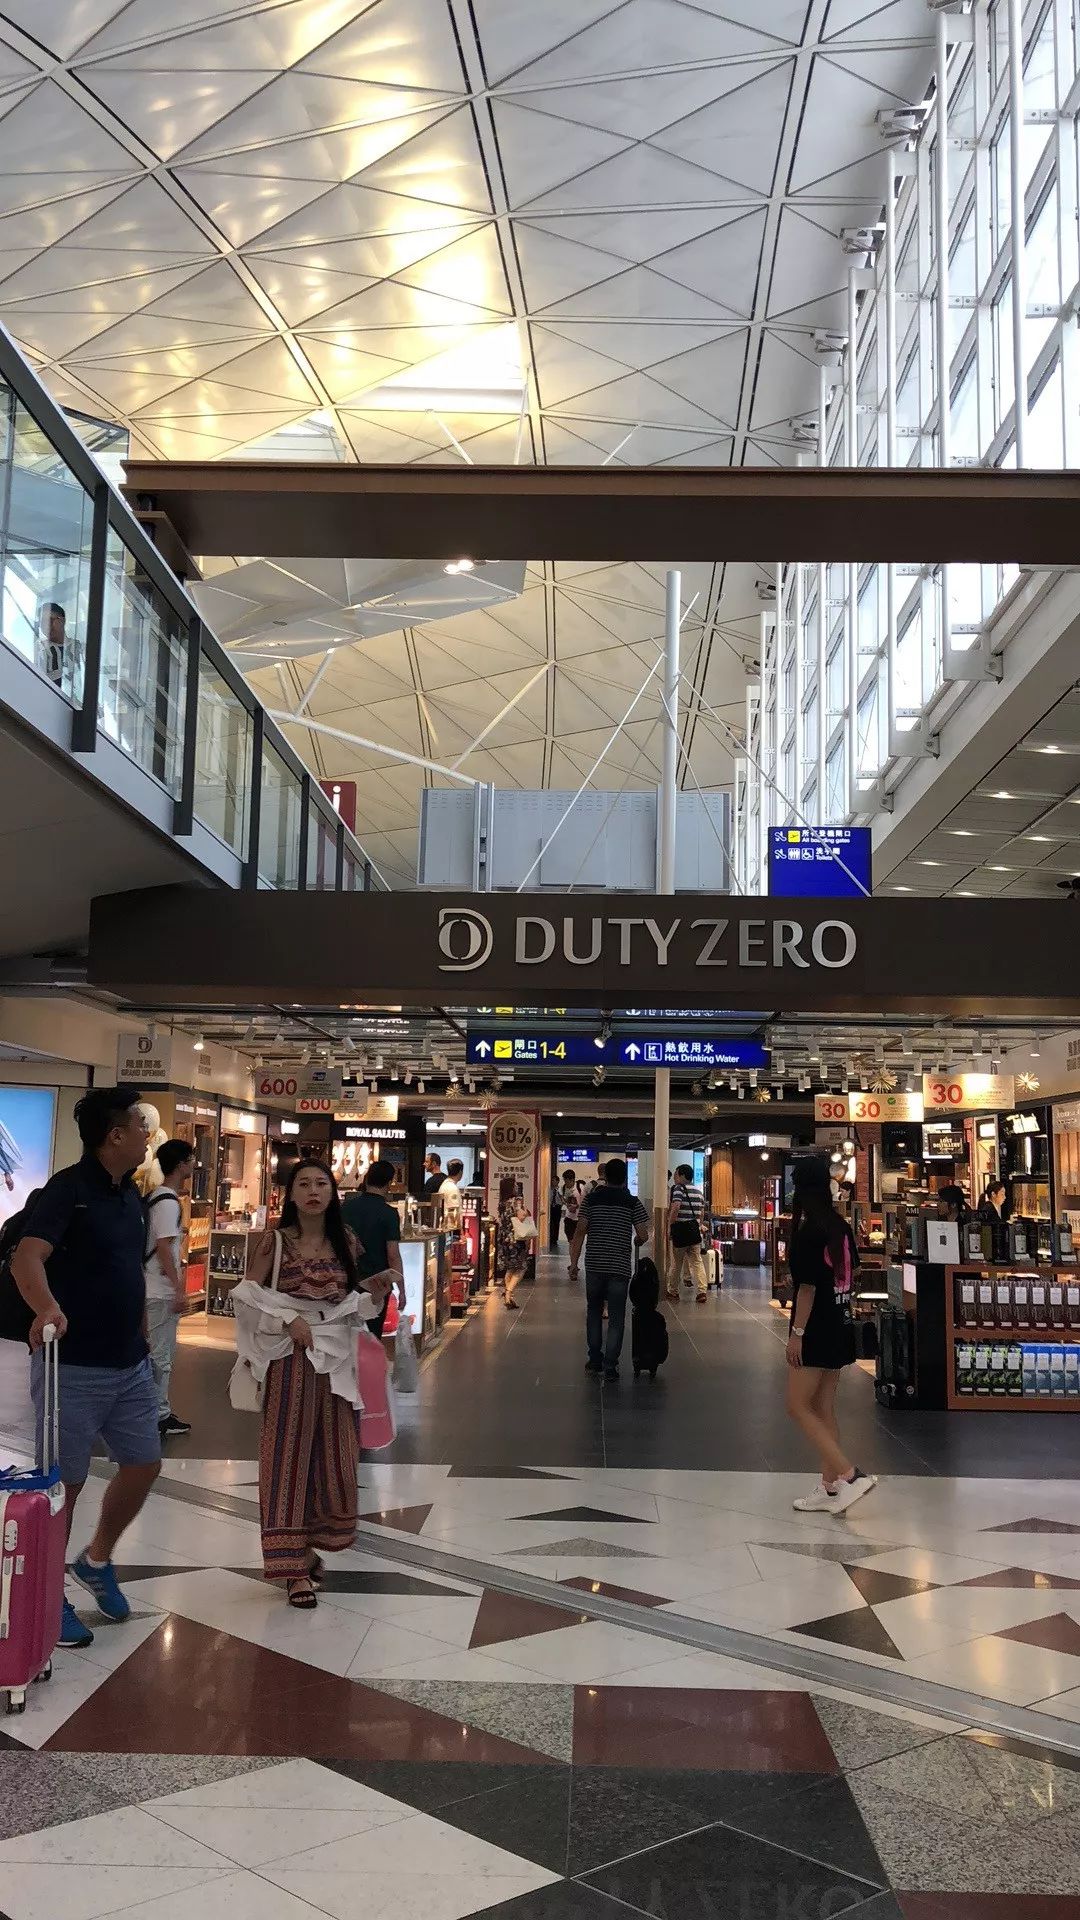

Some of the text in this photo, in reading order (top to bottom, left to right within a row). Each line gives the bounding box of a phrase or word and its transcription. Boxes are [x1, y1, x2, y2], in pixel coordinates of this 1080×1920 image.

[514, 916, 858, 969] DUTY ZERO
[514, 1039, 537, 1050] 閘口
[540, 1041, 567, 1059] 1-4
[664, 1041, 715, 1053] 熱飲用水
[514, 1050, 538, 1059] Gates
[664, 1053, 740, 1064] Hot Drinking Water
[120, 1069, 166, 1077] GRAND OPENING
[260, 1078, 298, 1096] 600
[346, 1126, 406, 1139] ROYAL SALUTE
[495, 1127, 532, 1144] 50%
